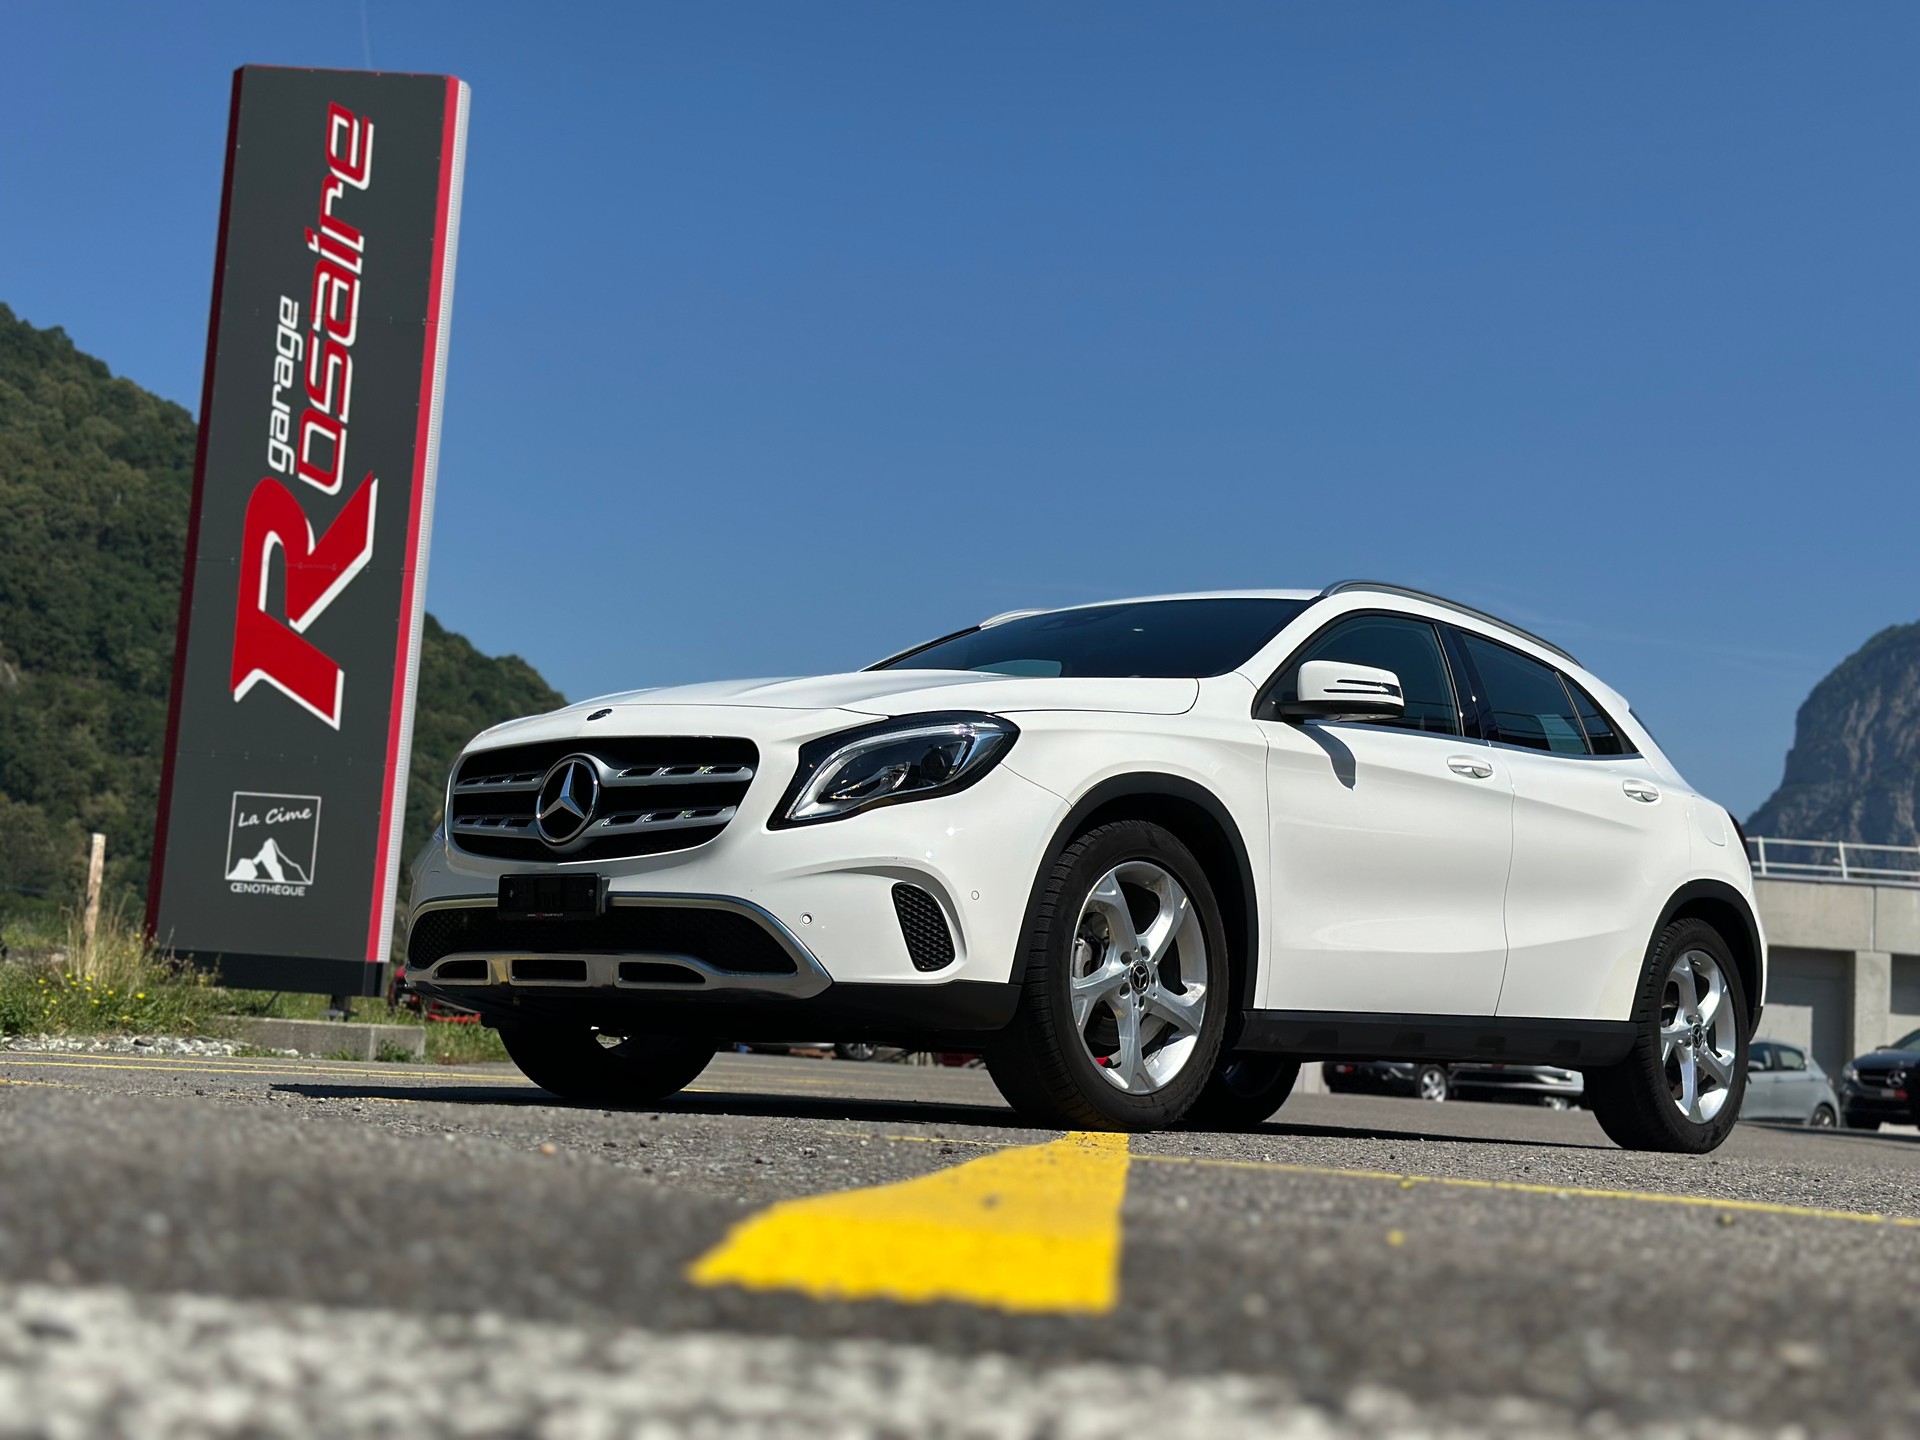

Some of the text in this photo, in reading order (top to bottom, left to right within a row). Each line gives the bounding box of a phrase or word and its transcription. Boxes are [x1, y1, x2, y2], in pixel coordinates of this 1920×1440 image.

[268, 295, 303, 475] garage
[238, 807, 312, 827] La Cime
